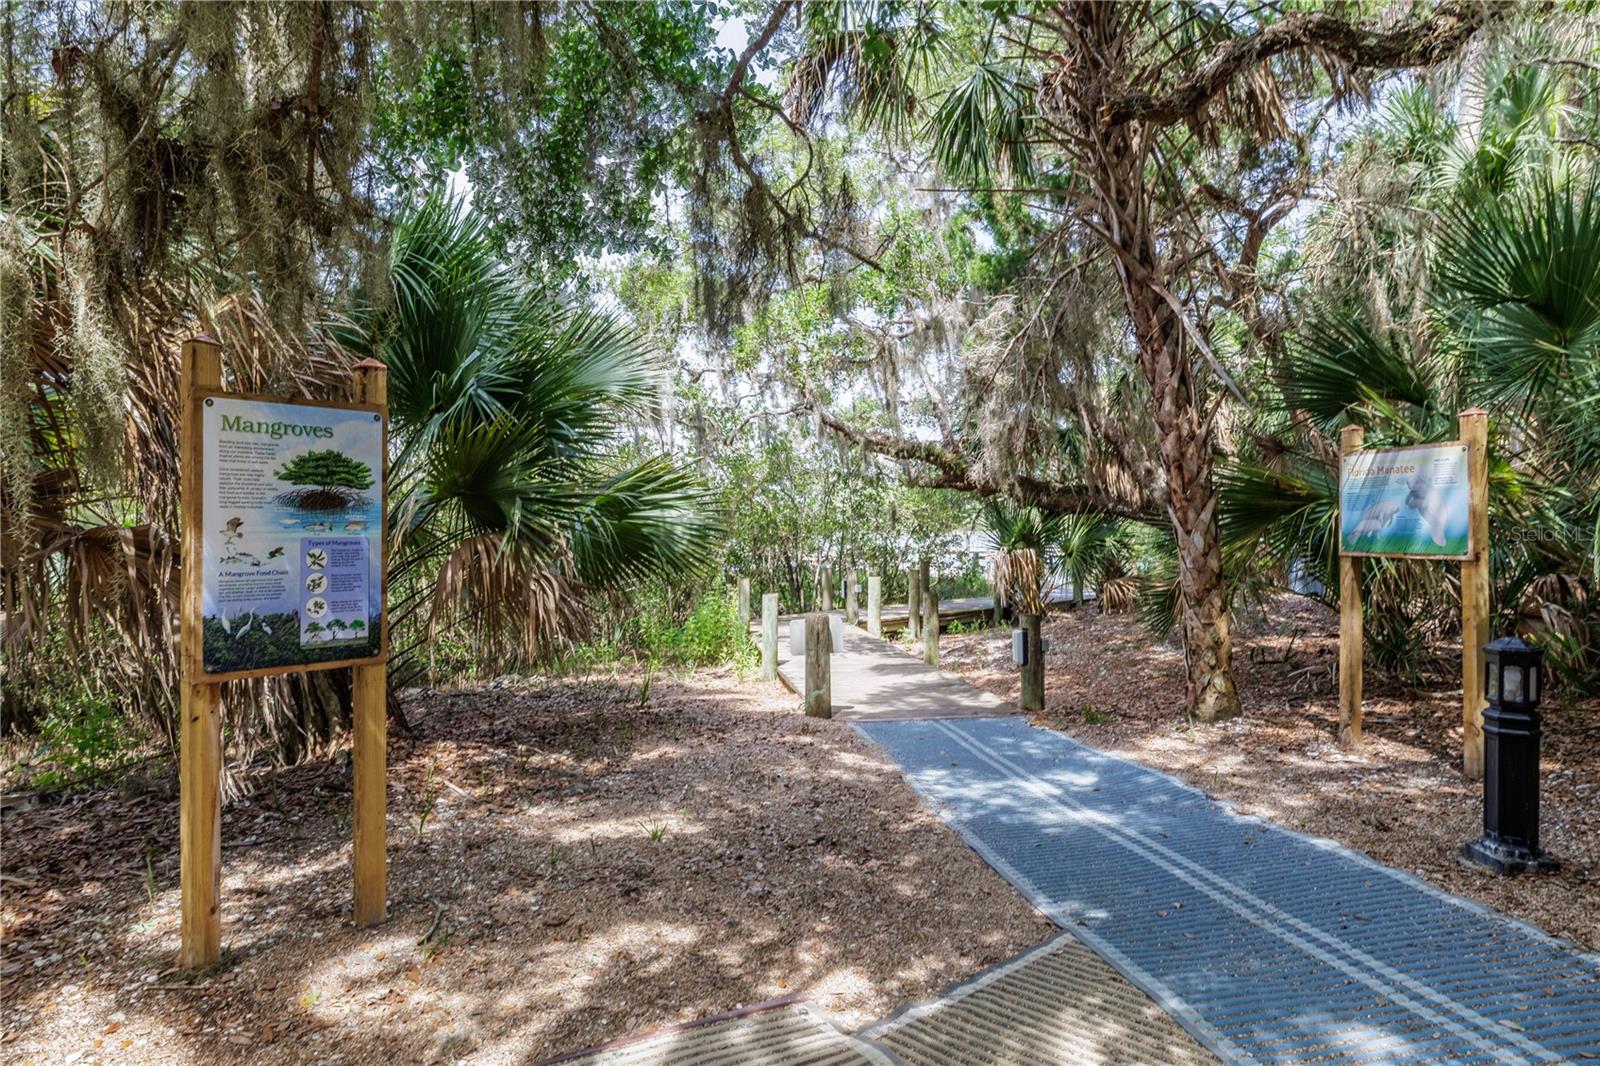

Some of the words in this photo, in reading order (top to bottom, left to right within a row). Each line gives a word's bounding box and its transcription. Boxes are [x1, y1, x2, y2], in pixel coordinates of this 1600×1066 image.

[221, 414, 334, 440] Mangroves
[1377, 464, 1415, 475] Manatee
[218, 570, 224, 578] A
[224, 570, 256, 578] Mangrove
[256, 569, 272, 577] Food
[272, 568, 289, 576] Chain
